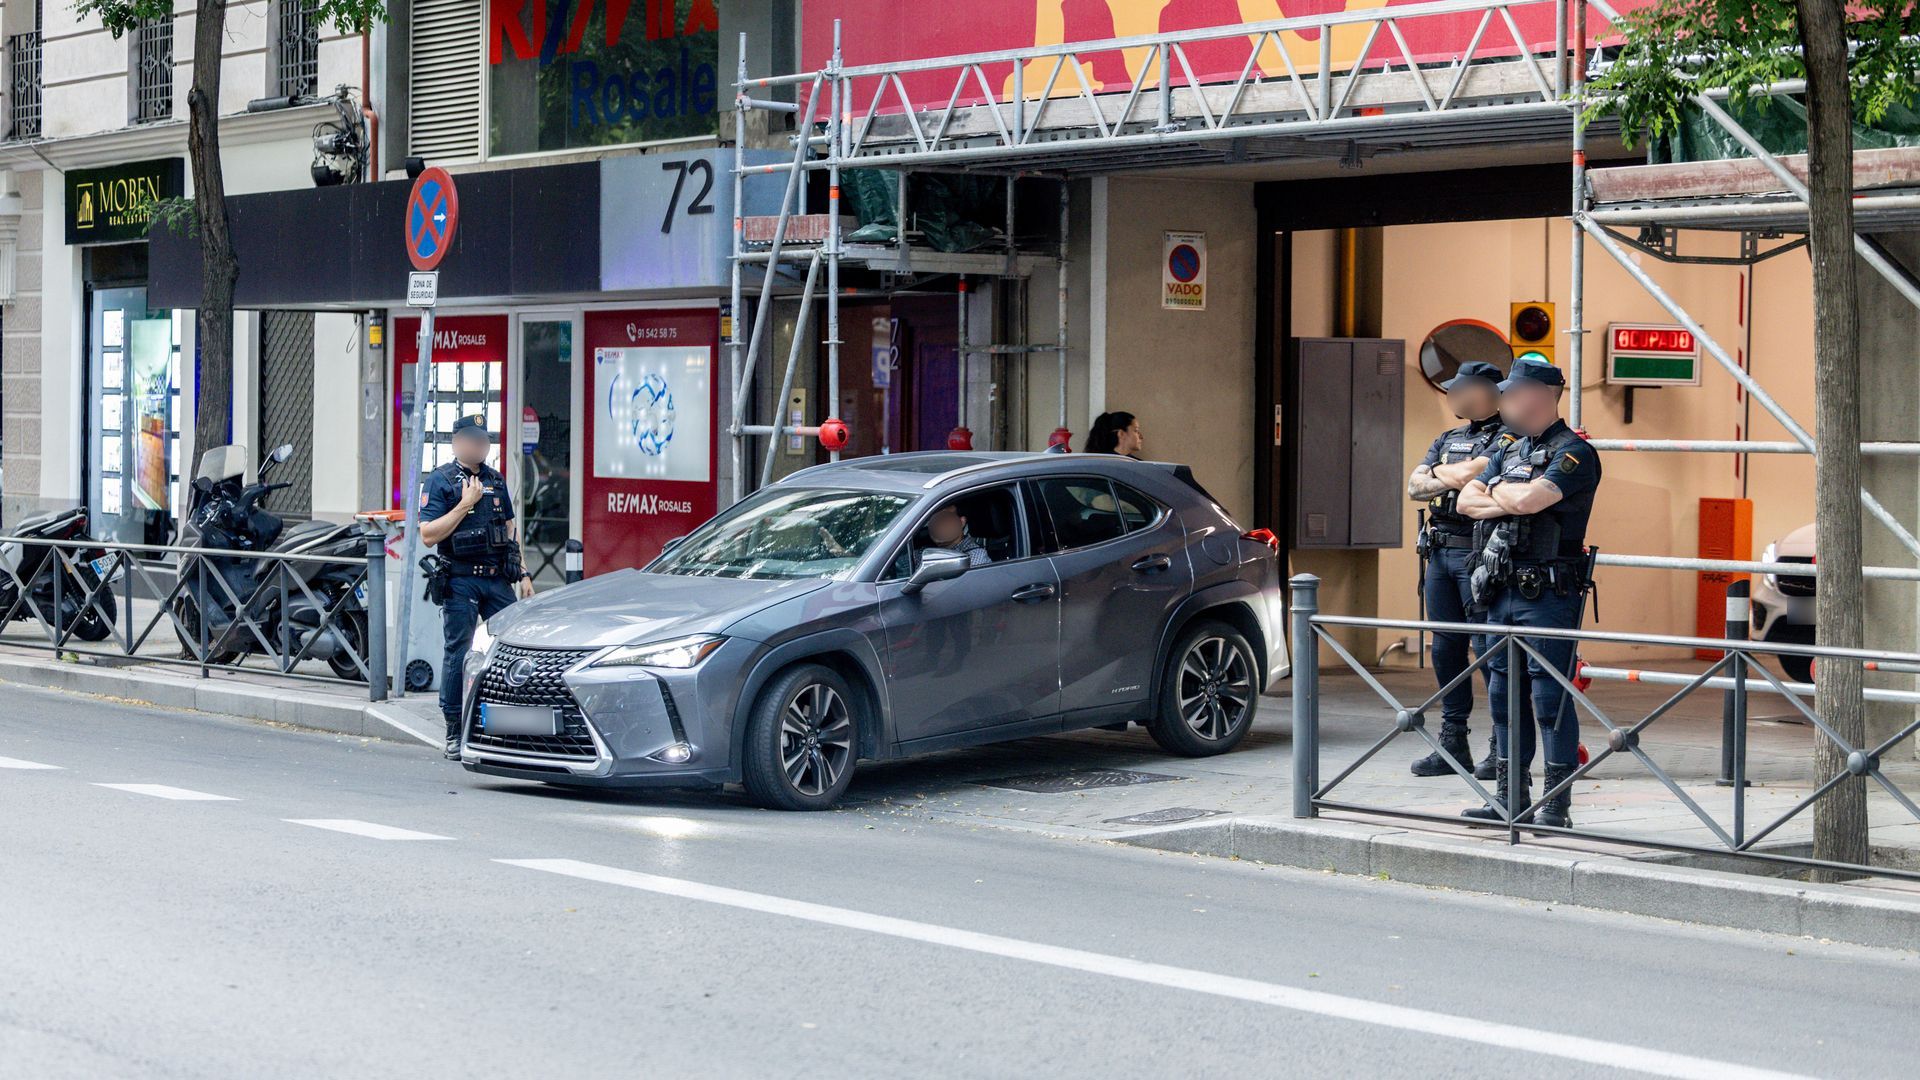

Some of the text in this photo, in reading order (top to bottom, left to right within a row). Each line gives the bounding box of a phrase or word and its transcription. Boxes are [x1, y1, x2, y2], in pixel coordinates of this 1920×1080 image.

[571, 47, 717, 129] Rosale
[99, 176, 160, 213] MOBEN
[660, 158, 715, 235] 72
[109, 216, 124, 226] REAL
[413, 280, 433, 289] ZONA DE
[1167, 283, 1203, 296] VADO
[410, 290, 434, 299] SEGURIDAD
[415, 330, 487, 349] RMAX ROSALES
[637, 327, 678, 339] 91 542 58 75
[608, 492, 692, 515] RE/MAX ROSALES
